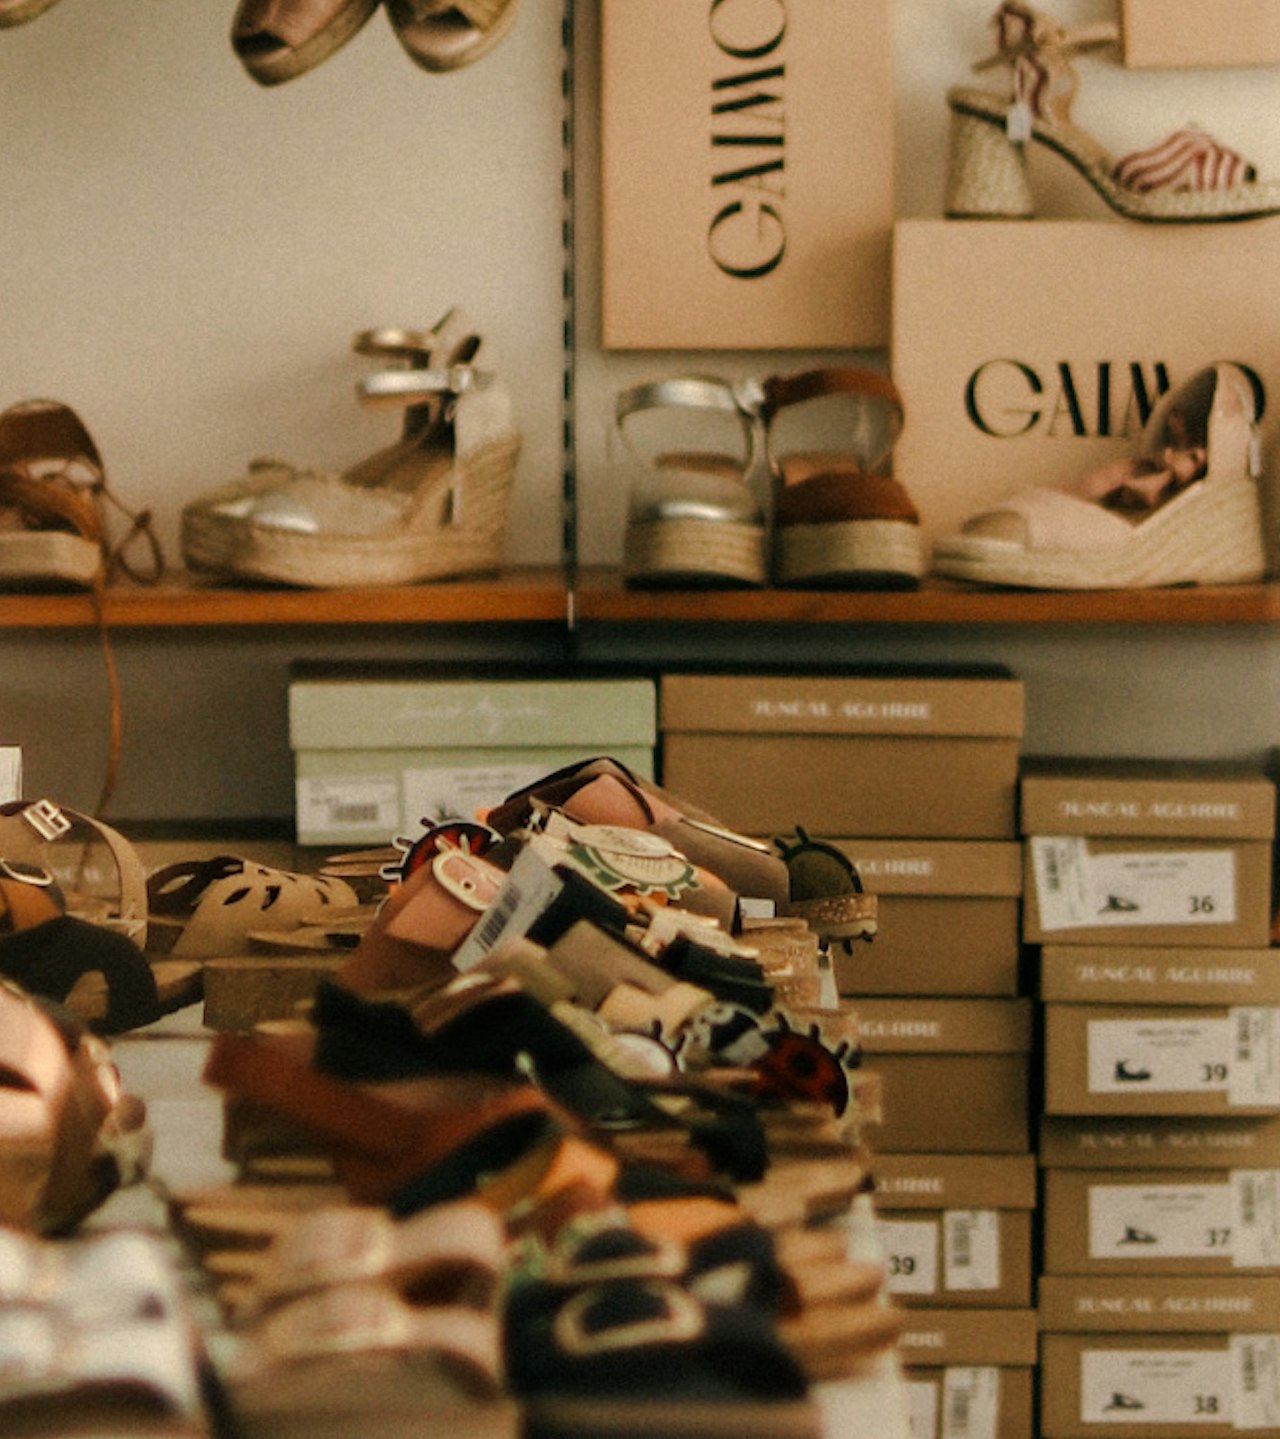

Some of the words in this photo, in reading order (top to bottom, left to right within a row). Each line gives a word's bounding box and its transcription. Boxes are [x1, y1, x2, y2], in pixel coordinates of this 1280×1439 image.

[1188, 895, 1217, 915] 36
[1201, 1064, 1228, 1083] 39
[1206, 1228, 1233, 1248] 37
[890, 1254, 917, 1276] 39
[1193, 1395, 1220, 1415] 38
